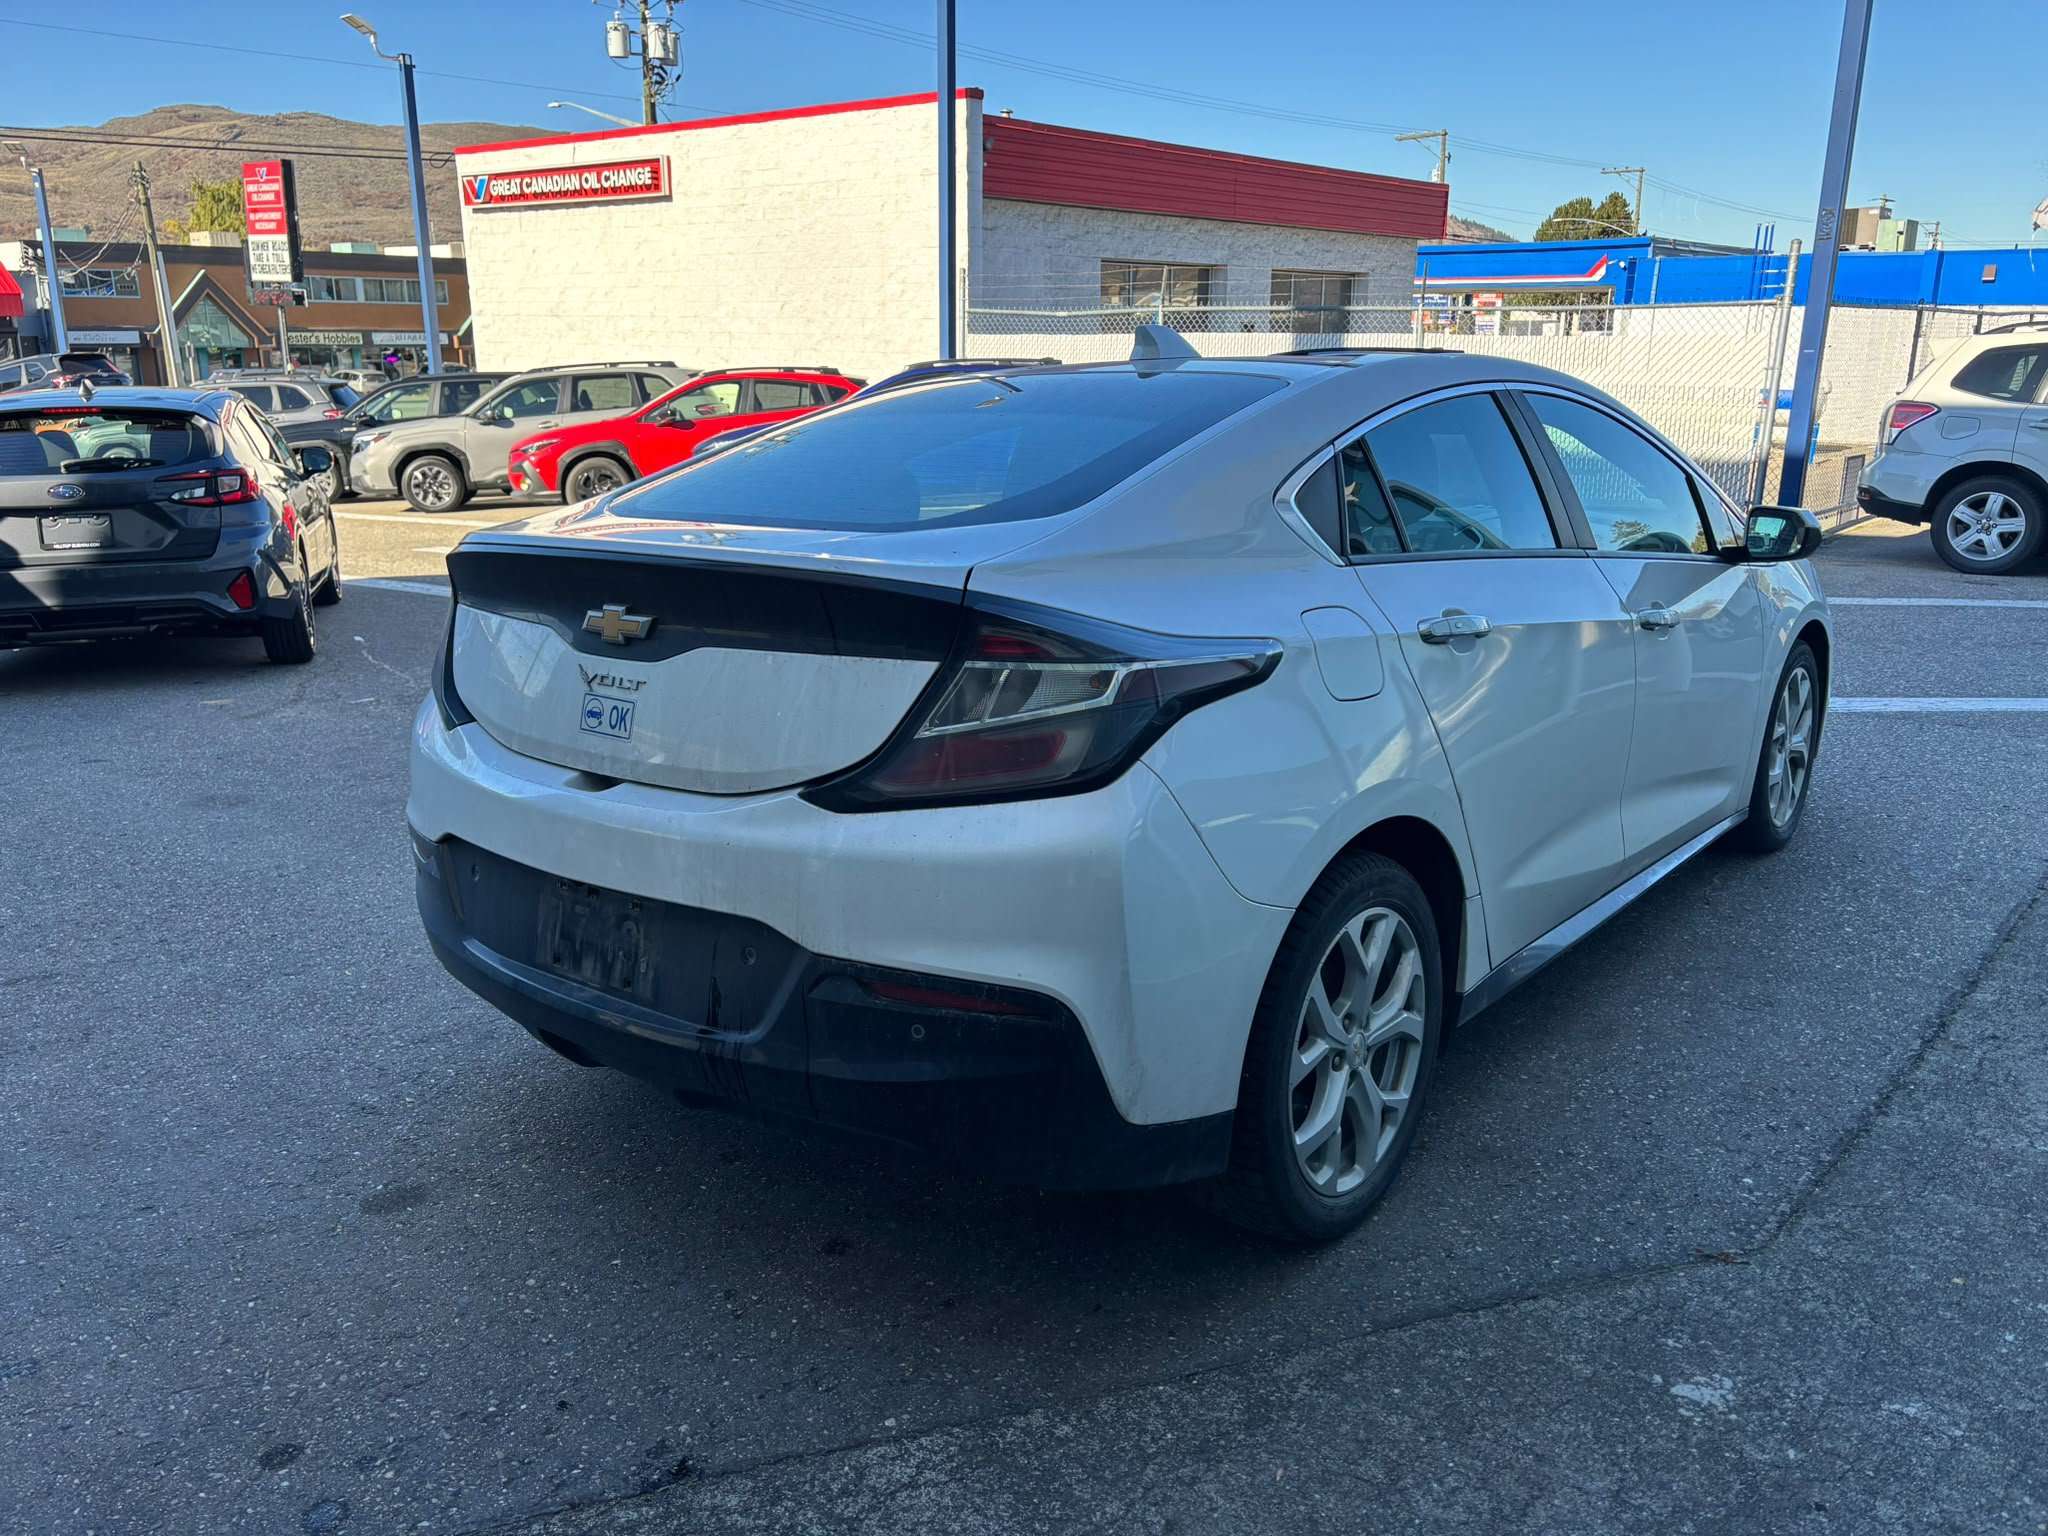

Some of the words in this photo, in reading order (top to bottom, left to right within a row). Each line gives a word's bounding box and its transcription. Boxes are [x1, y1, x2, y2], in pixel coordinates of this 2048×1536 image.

[490, 178, 522, 196] GREAT
[523, 173, 580, 194] CANADIAN
[581, 172, 601, 190] OIL
[601, 167, 652, 187] CHANGE
[272, 252, 286, 264] TOLL
[287, 333, 320, 344] ester's
[323, 333, 361, 345] Hobbies
[578, 663, 647, 692] VOLT
[609, 705, 630, 733] OK
